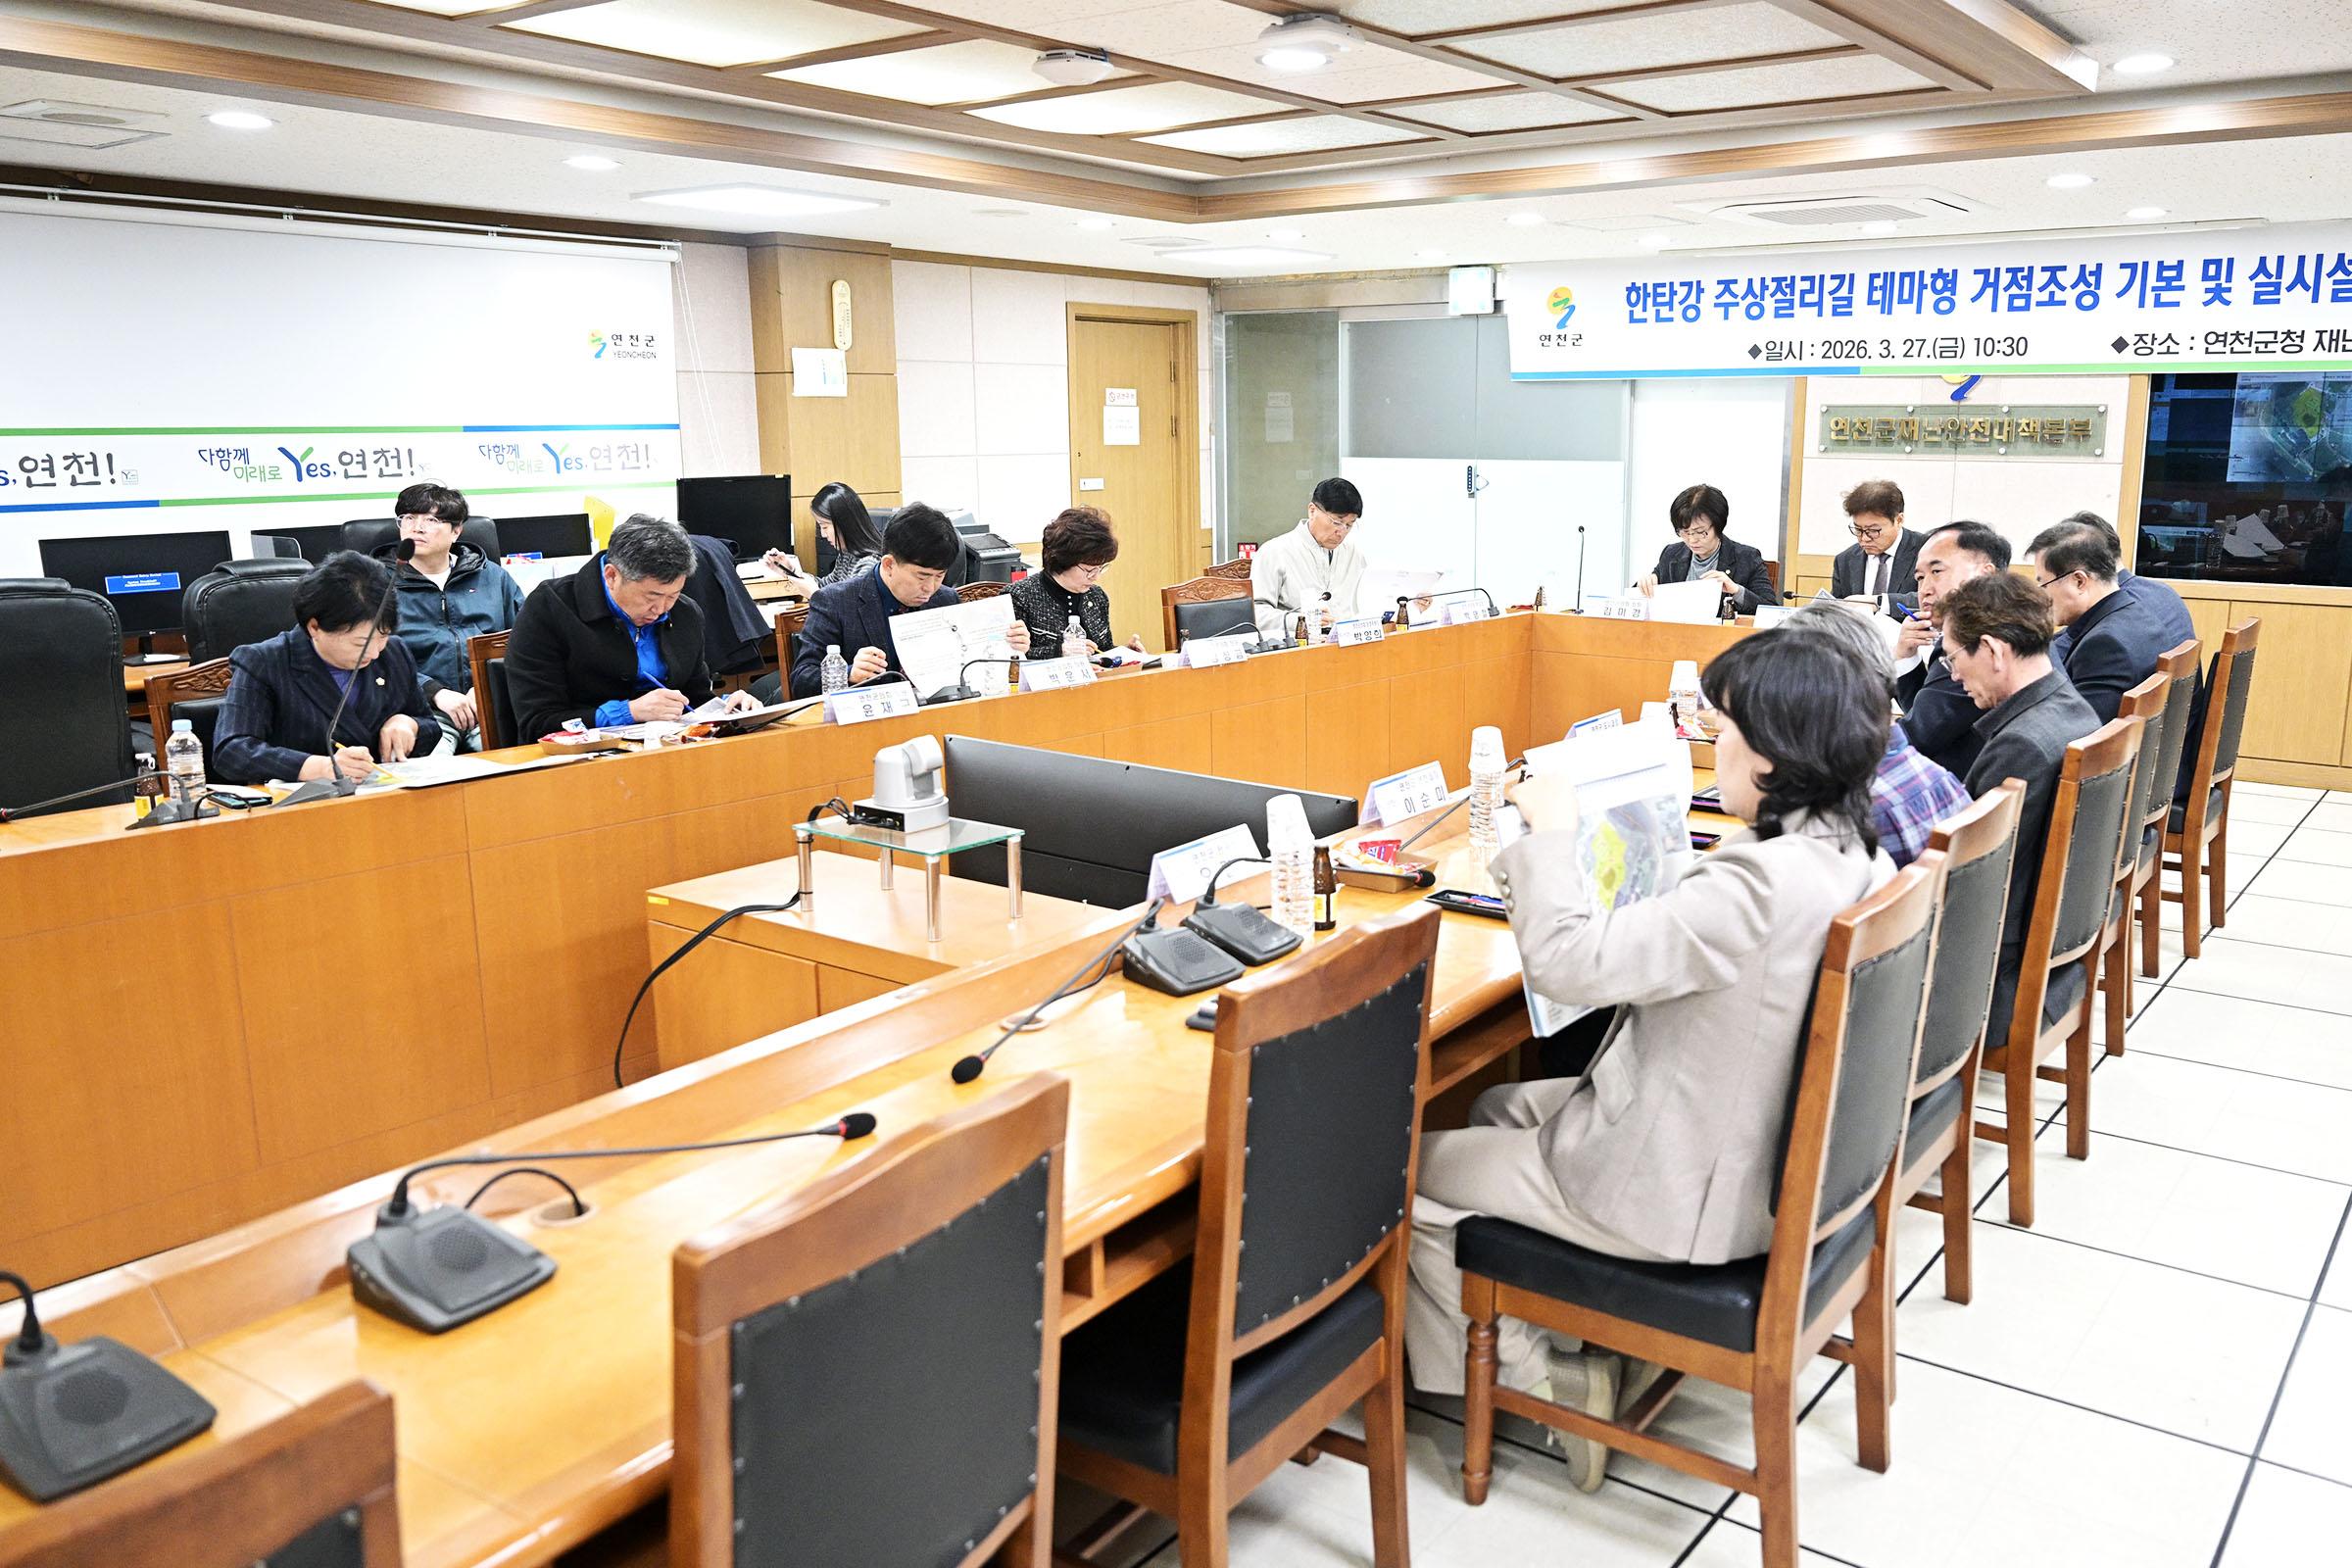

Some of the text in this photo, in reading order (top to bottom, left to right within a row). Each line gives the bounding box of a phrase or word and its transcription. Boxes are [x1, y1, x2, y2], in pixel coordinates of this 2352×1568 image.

[1626, 280, 1704, 323] 한탄강
[1714, 273, 1855, 320] 주상절리길
[1867, 269, 1958, 315] 테마형
[1971, 263, 2102, 313] 거점조성
[2116, 260, 2185, 308] 기본
[2201, 258, 2234, 307] 및
[612, 333, 655, 347] 연천군
[1540, 334, 1583, 347] 연천군
[1766, 341, 1802, 361] 일시
[1822, 340, 1871, 360] 2026.
[1880, 339, 1895, 359] 3.
[1903, 337, 1965, 360] 27.(금)
[1974, 337, 2029, 358] 10:30
[2133, 333, 2180, 356] 장소
[2204, 329, 2305, 354] 연천군청
[198, 447, 250, 471] 다함께
[338, 447, 415, 479] 연천!
[478, 443, 520, 465] 다함께
[590, 443, 650, 471] 연천!
[19, 452, 116, 488] 연천!
[233, 466, 282, 482] 미래로
